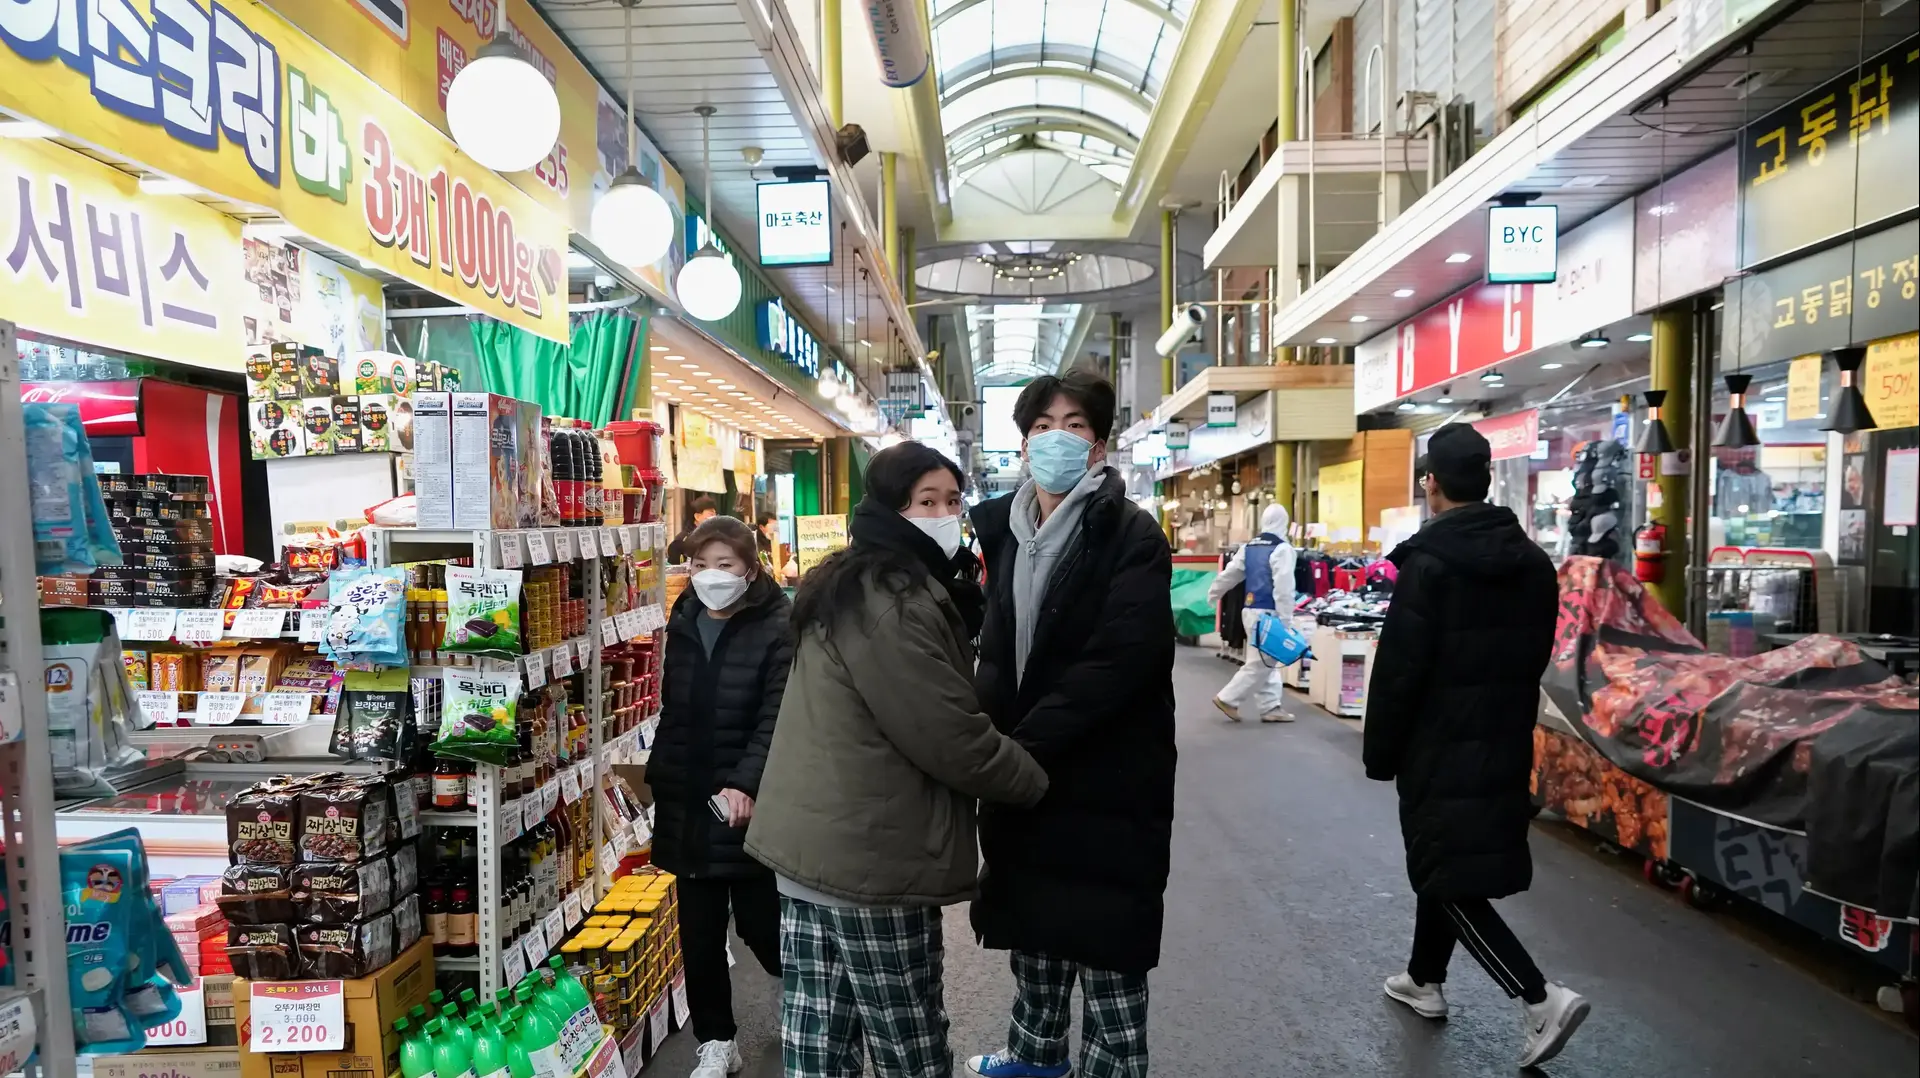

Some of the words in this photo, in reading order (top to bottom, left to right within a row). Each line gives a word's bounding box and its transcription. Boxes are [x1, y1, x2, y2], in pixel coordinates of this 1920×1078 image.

[1753, 50, 1919, 187] 교동닭
[289, 70, 349, 192] 바
[765, 210, 823, 228] 마포축산
[1503, 225, 1543, 244] BYC
[6, 174, 217, 331] 서비스
[292, 553, 334, 566] ABC
[263, 589, 304, 602] ABC
[459, 581, 508, 598] 목캔디
[458, 681, 507, 698] 목캔디
[354, 701, 396, 711] 브라질너트
[239, 822, 288, 838] 짜장면
[306, 818, 355, 834] 짜장면
[249, 877, 279, 890] 짜장면
[312, 877, 341, 889] 짜장면
[203, 889, 220, 902] POC
[321, 930, 348, 942] 짜장면
[304, 985, 329, 993] SALE
[284, 1014, 316, 1024] 3,000
[262, 1025, 327, 1045] 2,200
